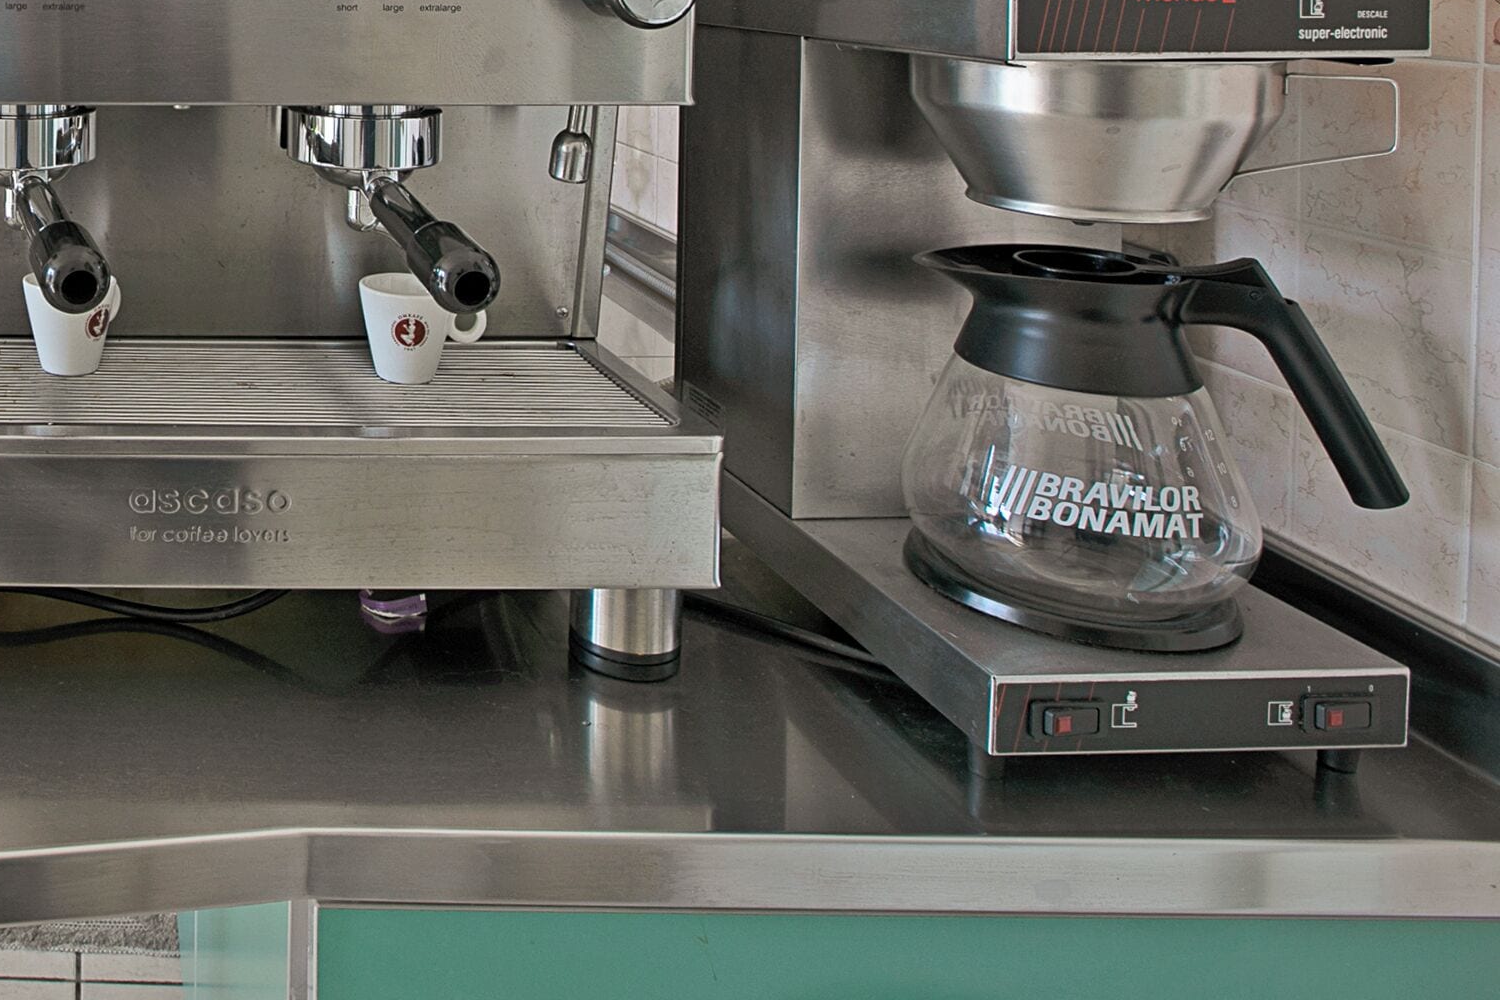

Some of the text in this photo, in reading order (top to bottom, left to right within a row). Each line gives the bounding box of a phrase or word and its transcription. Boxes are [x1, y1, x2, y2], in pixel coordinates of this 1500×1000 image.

[5, 2, 28, 12] large
[42, 2, 85, 12] extralarge
[337, 4, 358, 12] short
[382, 4, 404, 13] large
[420, 4, 462, 13] extralarge
[1357, 10, 1389, 18] DESCALE
[1298, 26, 1388, 42] super-electronic
[1035, 472, 1202, 512] BRAVILOR
[128, 488, 292, 514] ascaso
[1026, 496, 1204, 538] BONAMAT
[128, 526, 291, 543] for coffee lovers
